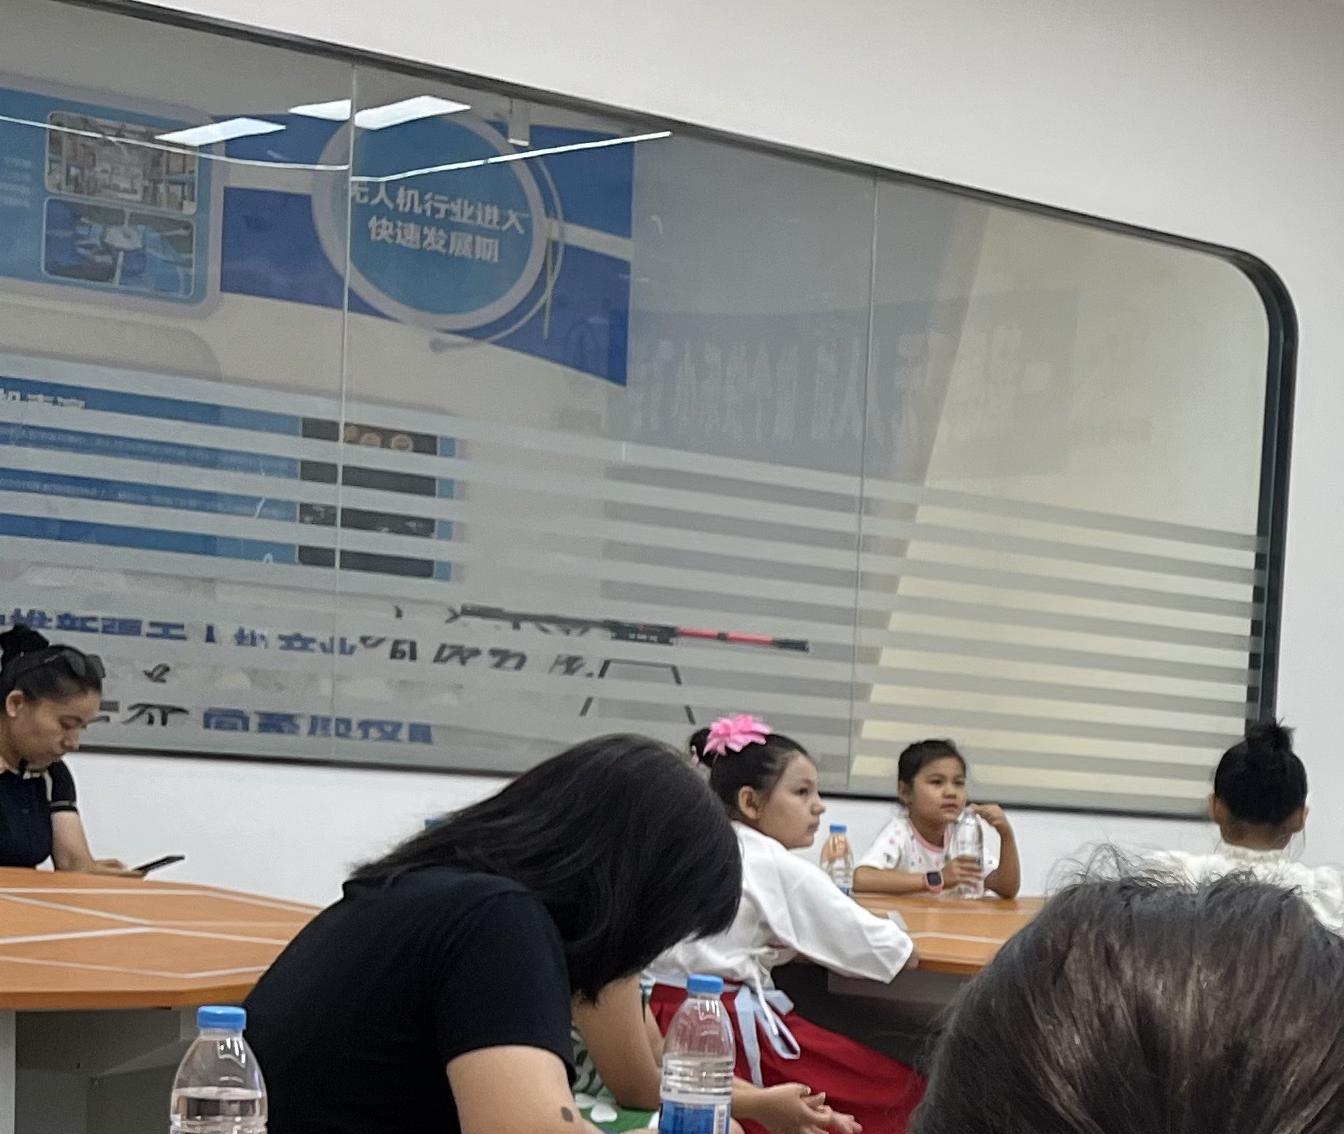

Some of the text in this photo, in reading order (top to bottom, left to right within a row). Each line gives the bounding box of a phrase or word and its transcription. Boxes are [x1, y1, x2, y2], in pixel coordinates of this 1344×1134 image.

[368, 215, 499, 263] 快速发展期
